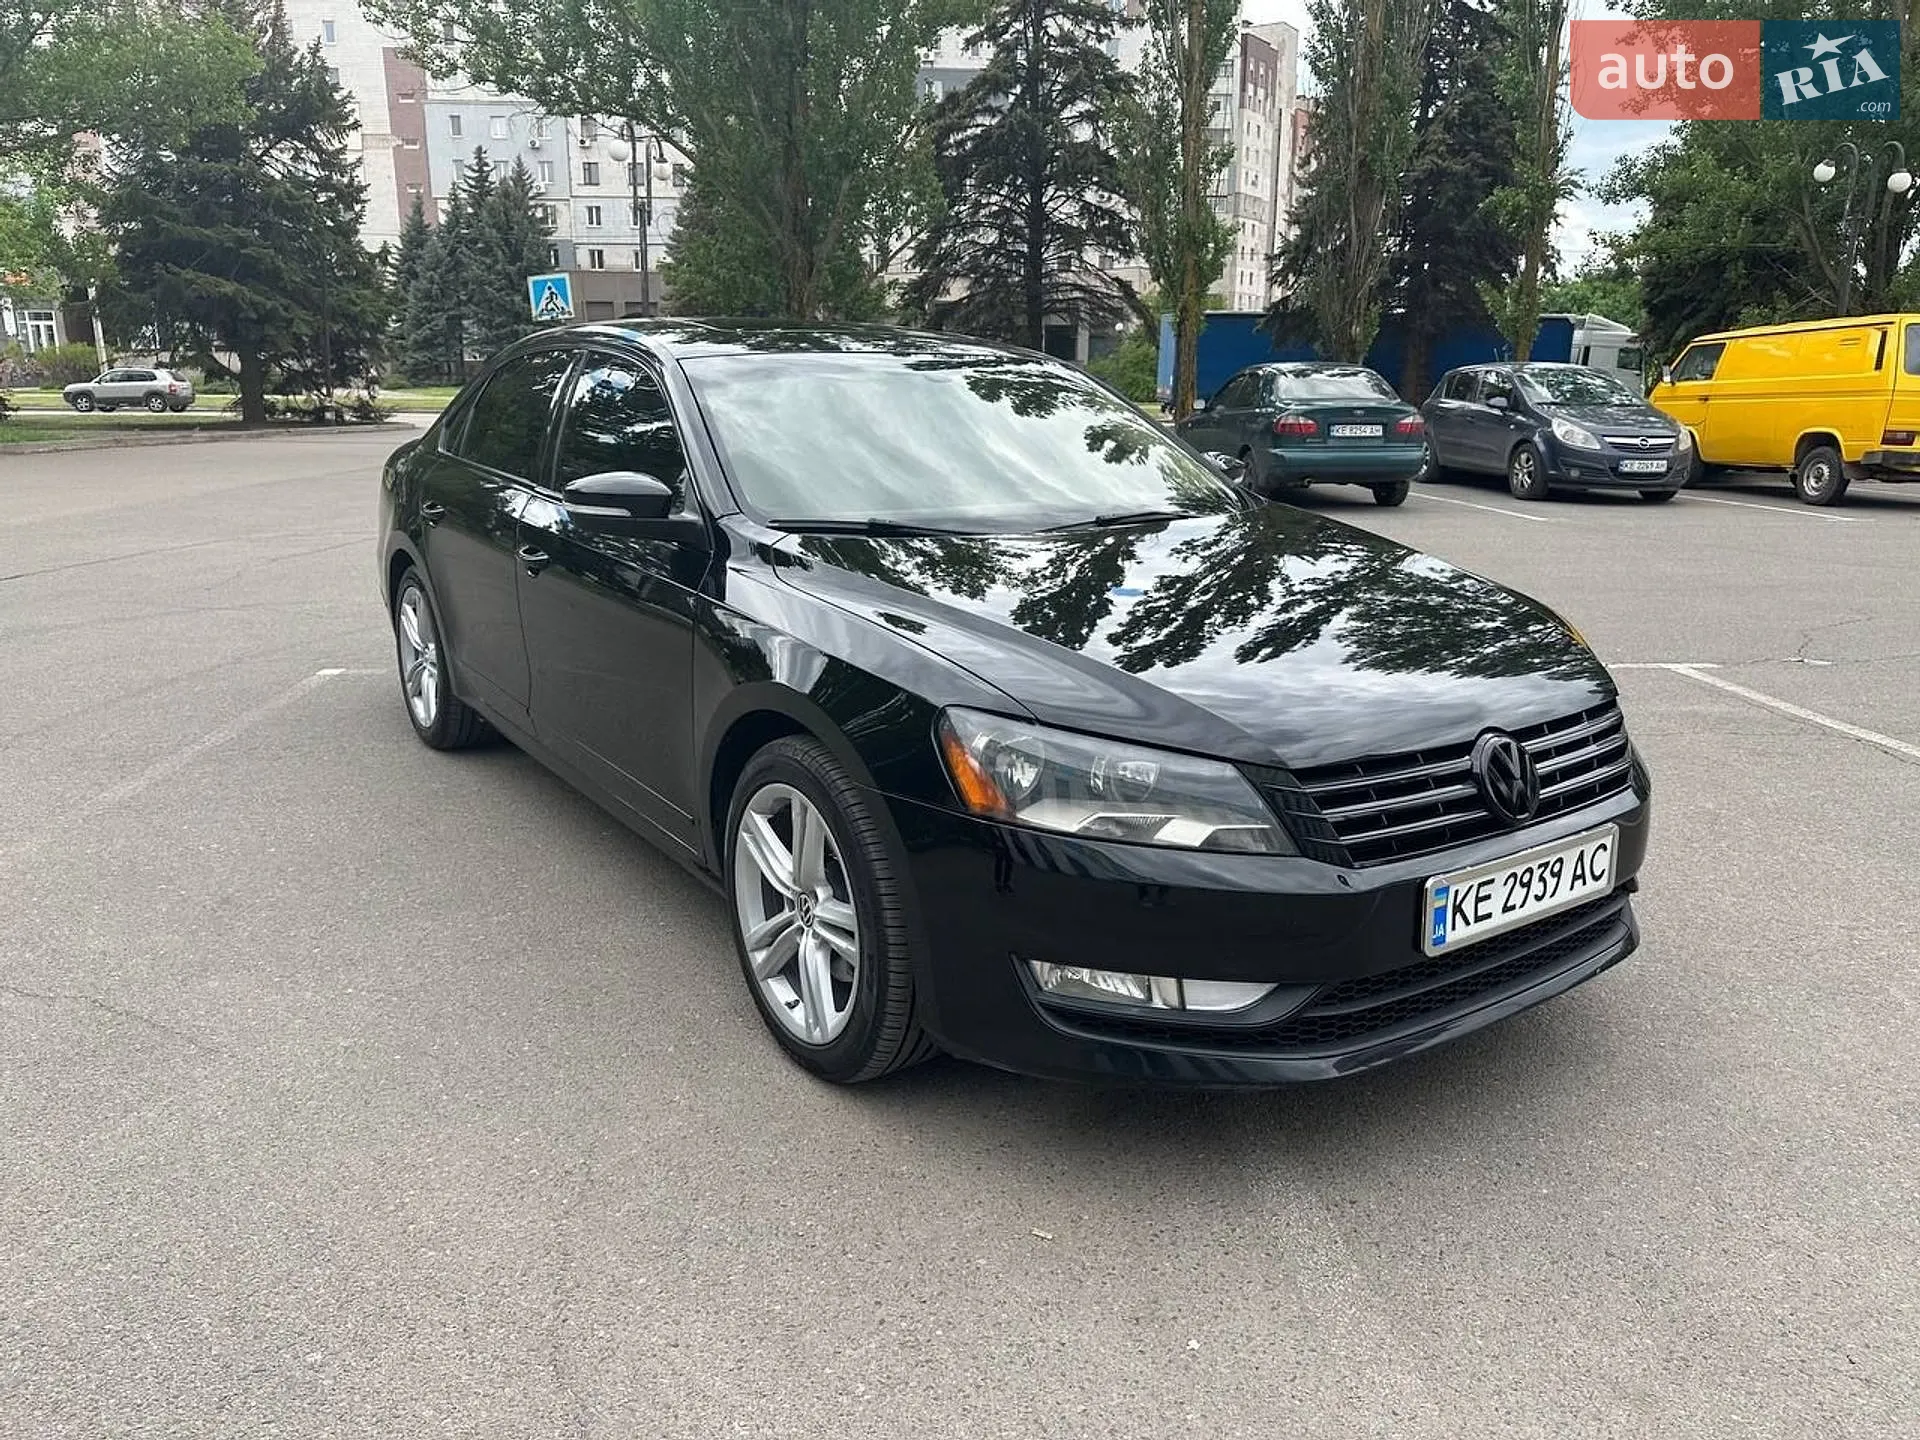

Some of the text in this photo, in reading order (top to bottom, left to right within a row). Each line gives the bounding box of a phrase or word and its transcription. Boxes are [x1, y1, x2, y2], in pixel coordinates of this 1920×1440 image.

[1336, 425, 1347, 435] KE
[1368, 425, 1381, 435] AH
[1451, 843, 1608, 931] KE 2939 AC
